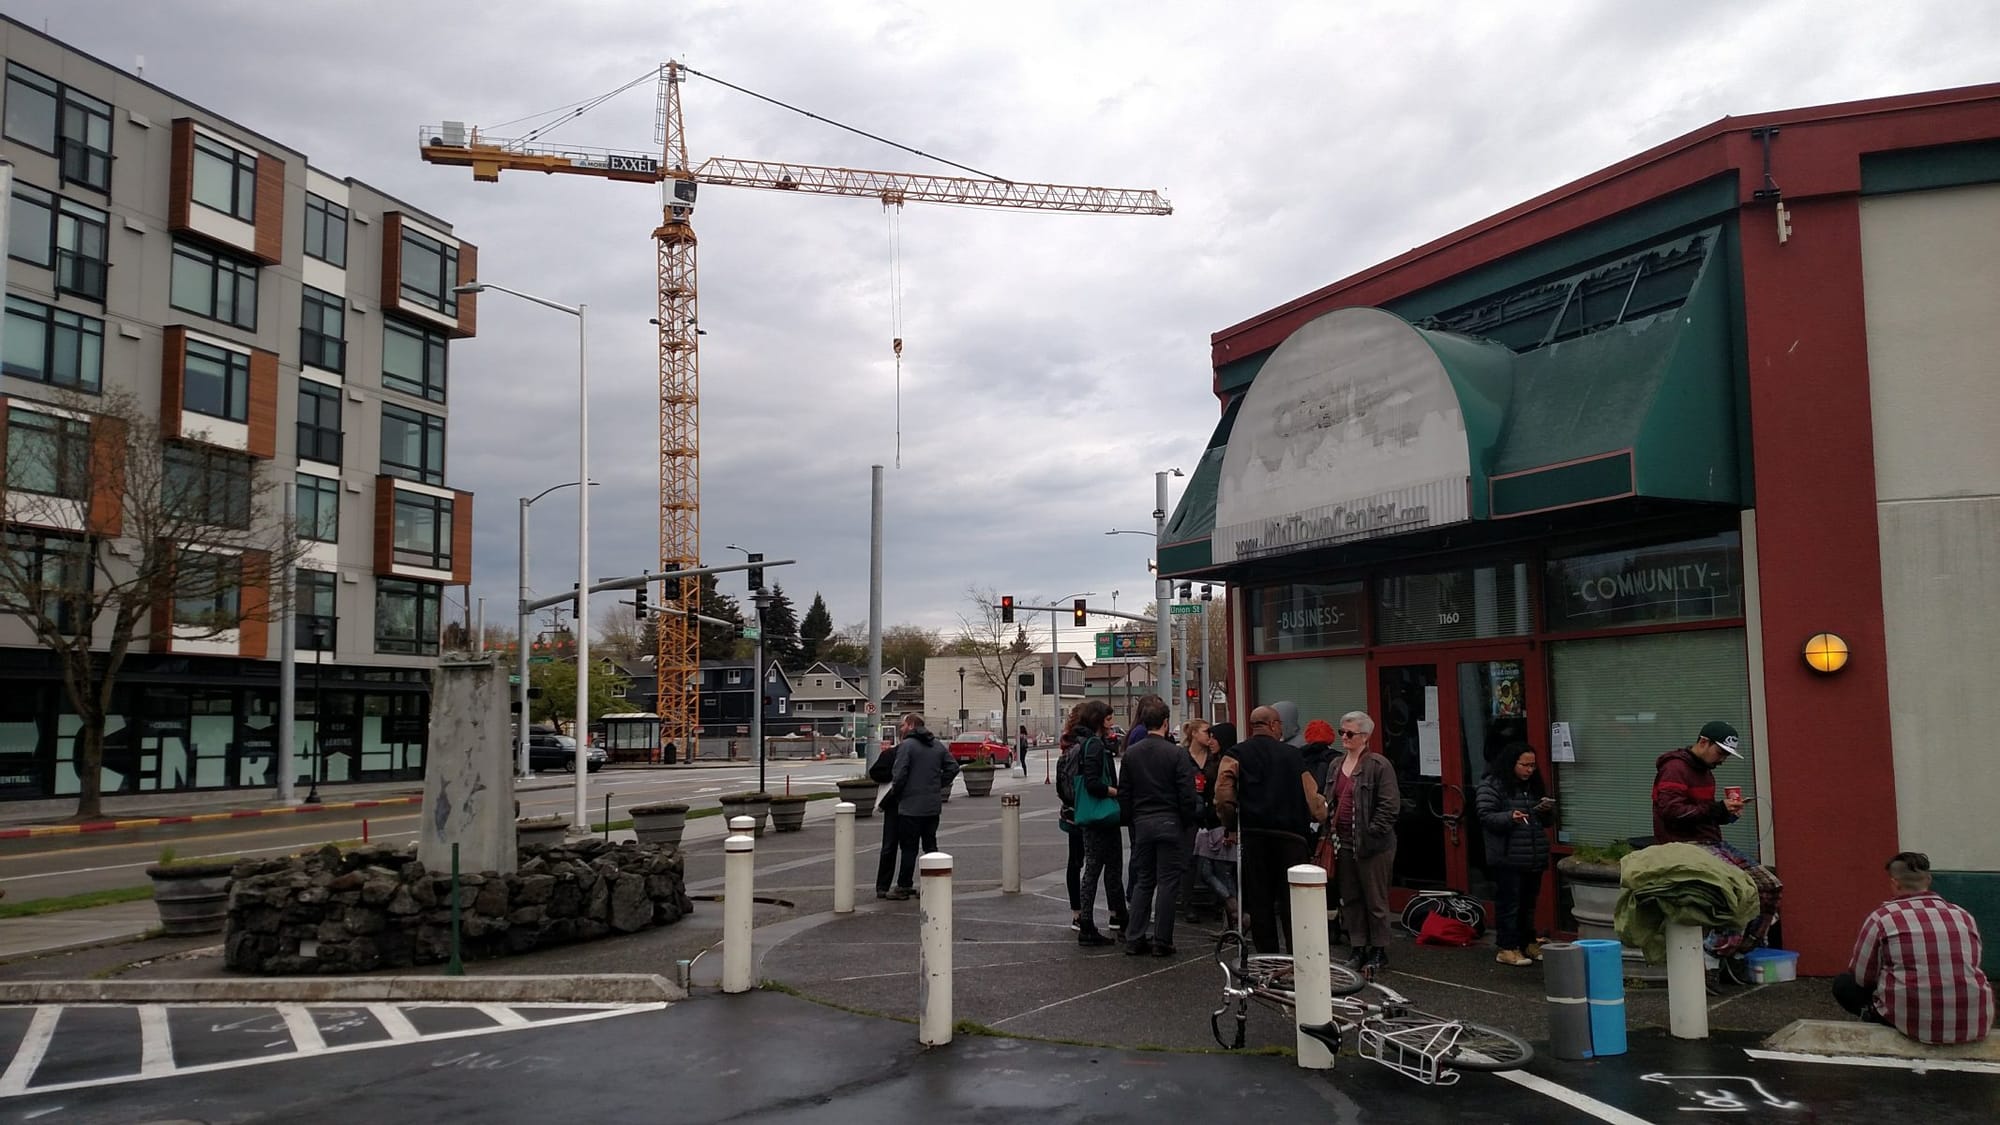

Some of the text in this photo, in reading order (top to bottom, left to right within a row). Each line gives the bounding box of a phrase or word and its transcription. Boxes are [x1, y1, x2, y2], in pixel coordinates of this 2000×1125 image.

[611, 156, 656, 173] EXXEL
[1170, 605, 1200, 614] Union St
[1438, 612, 1460, 625] 1160
[0, 775, 31, 784] ENTRAL
